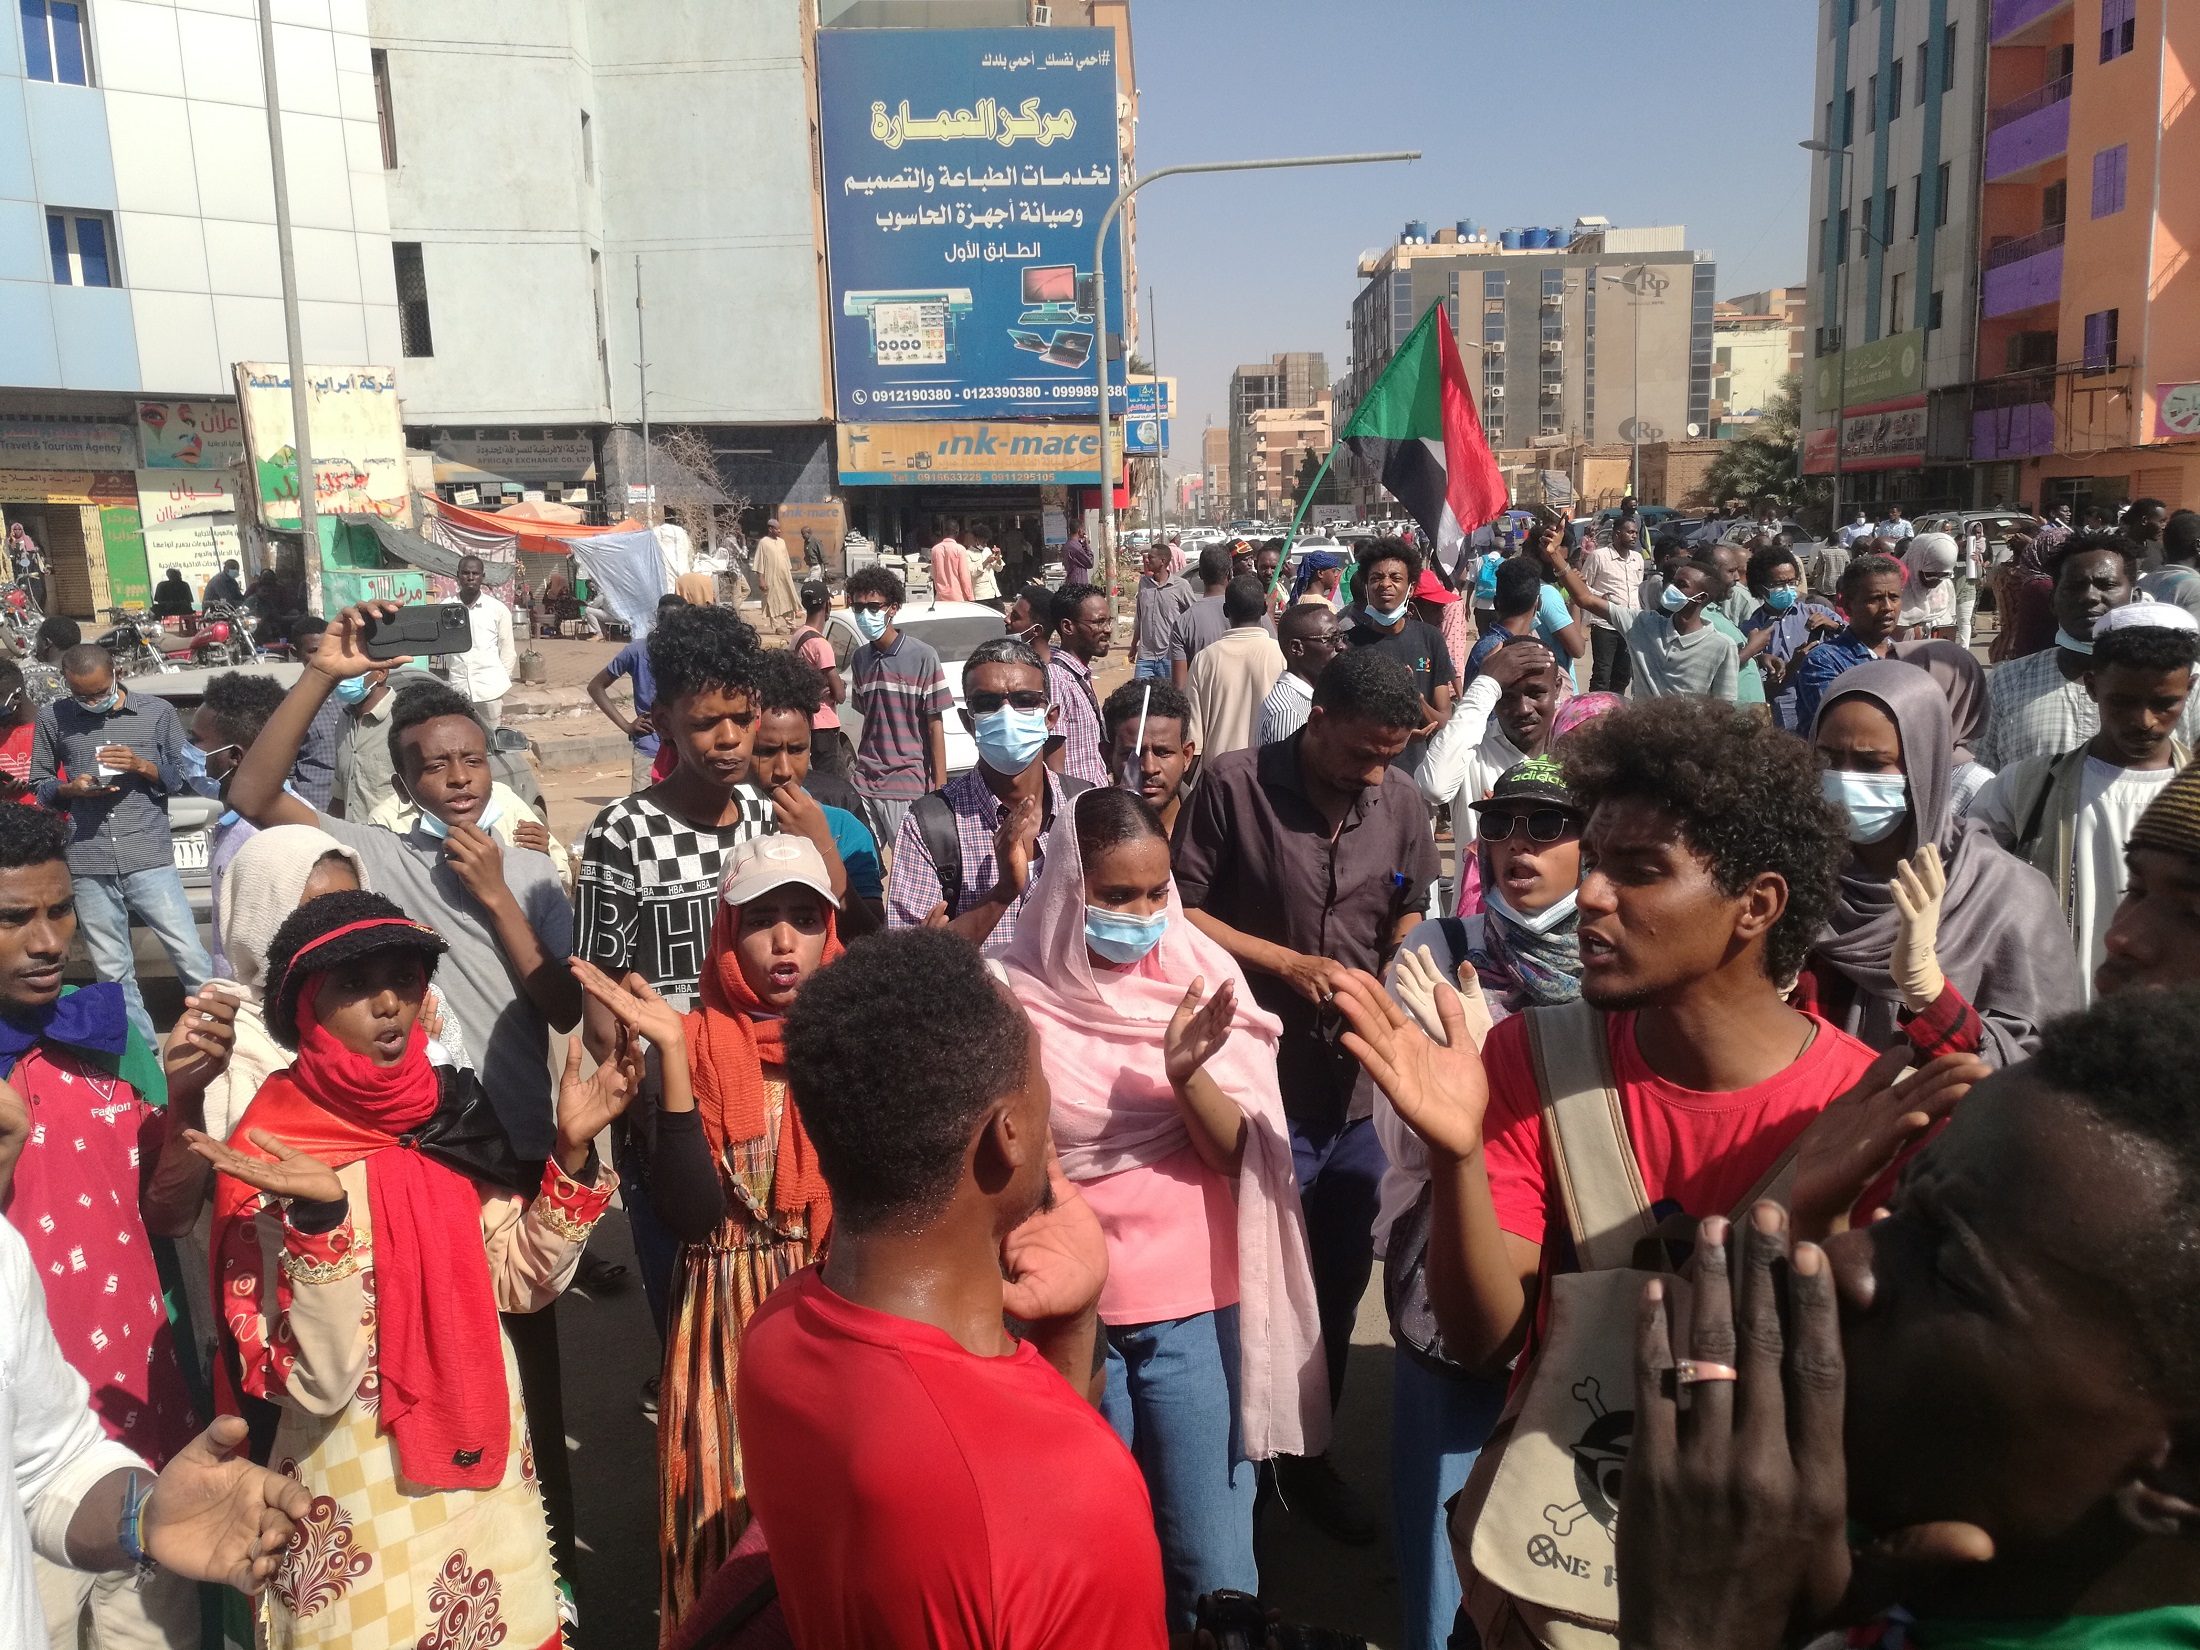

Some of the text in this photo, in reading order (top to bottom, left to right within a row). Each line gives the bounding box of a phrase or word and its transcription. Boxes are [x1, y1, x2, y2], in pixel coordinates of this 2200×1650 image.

[981, 52, 1007, 68] بلدك
[871, 97, 1077, 150] مركز العمارة
[844, 163, 1112, 197] لخدمات الطباعة والتصميم
[875, 198, 1084, 232] وصيانة أجهزة الحاسوب
[944, 242, 1041, 263] الطابق الأول
[357, 372, 396, 394] شركة
[872, 388, 952, 403] 0912190380
[962, 386, 1042, 400] 0123390380
[42, 441, 85, 453] Tourism
[85, 442, 122, 454] Agency
[477, 457, 513, 465] AFRICAN
[515, 456, 559, 464] EXCHANGE
[169, 478, 224, 501] كيان
[1510, 769, 1568, 789] adidas
[581, 864, 597, 877] HBA
[642, 886, 655, 897] BA
[668, 884, 685, 895] HBA
[696, 879, 711, 891] HBA
[675, 984, 693, 994] HBA
[1527, 1534, 1591, 1580] ONE
